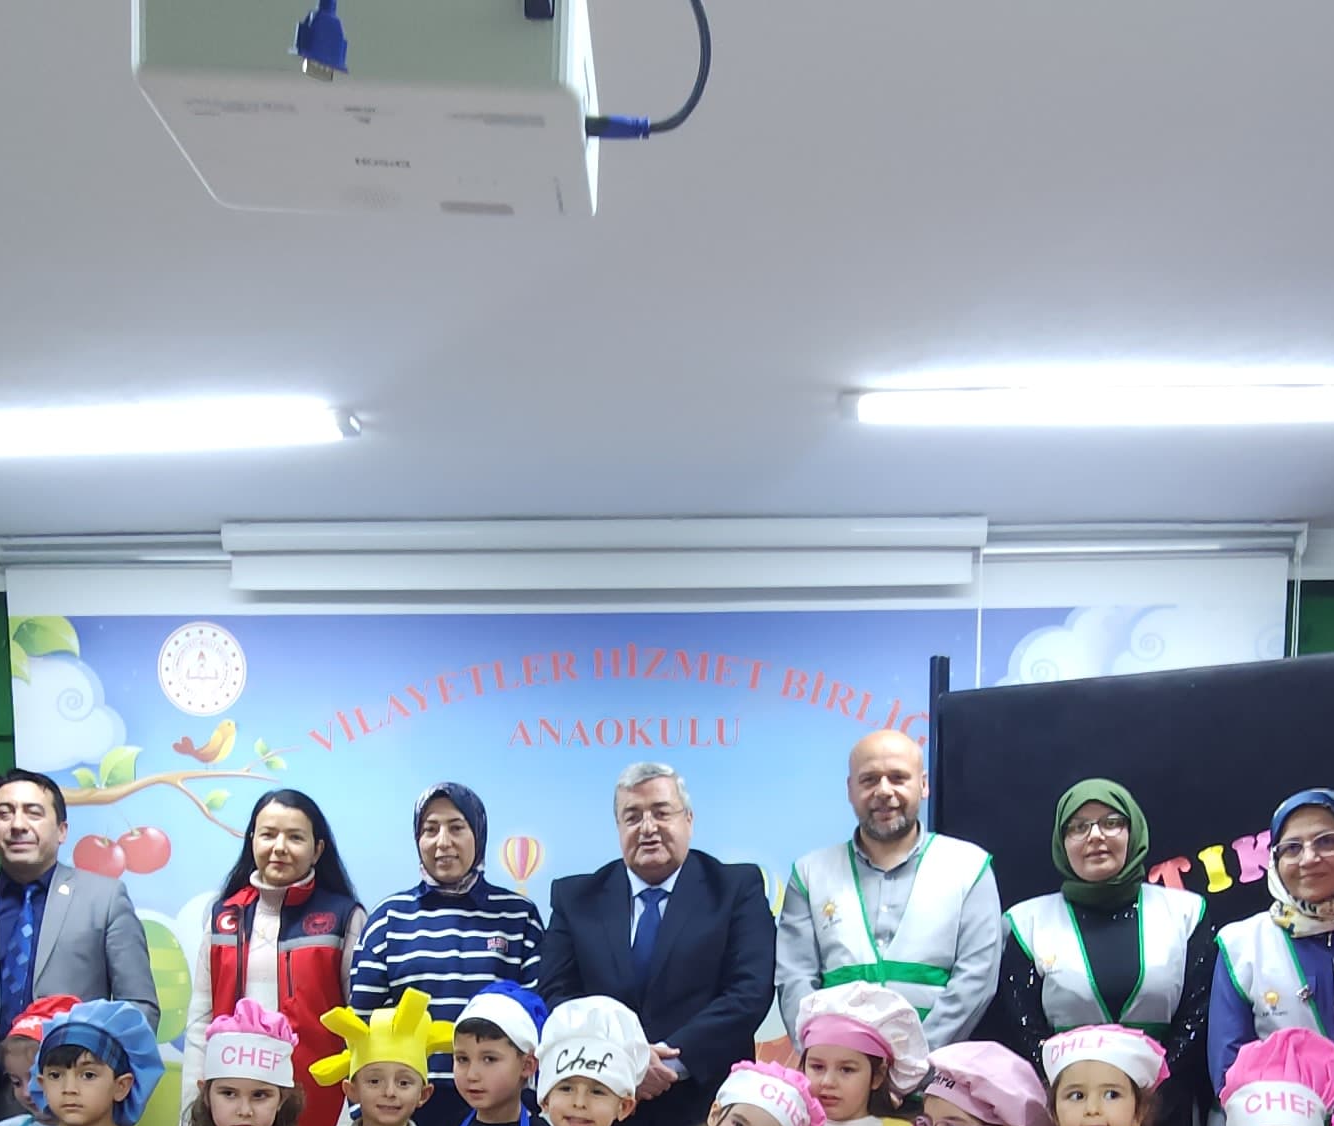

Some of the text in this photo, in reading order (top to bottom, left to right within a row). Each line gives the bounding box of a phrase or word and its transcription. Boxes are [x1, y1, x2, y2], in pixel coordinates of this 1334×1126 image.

[593, 642, 772, 692] HİZMET
[509, 717, 740, 747] ANAOKULU
[221, 1045, 283, 1071] CHEF
[556, 1046, 613, 1074] Chef
[1245, 1091, 1317, 1118] CHEF
